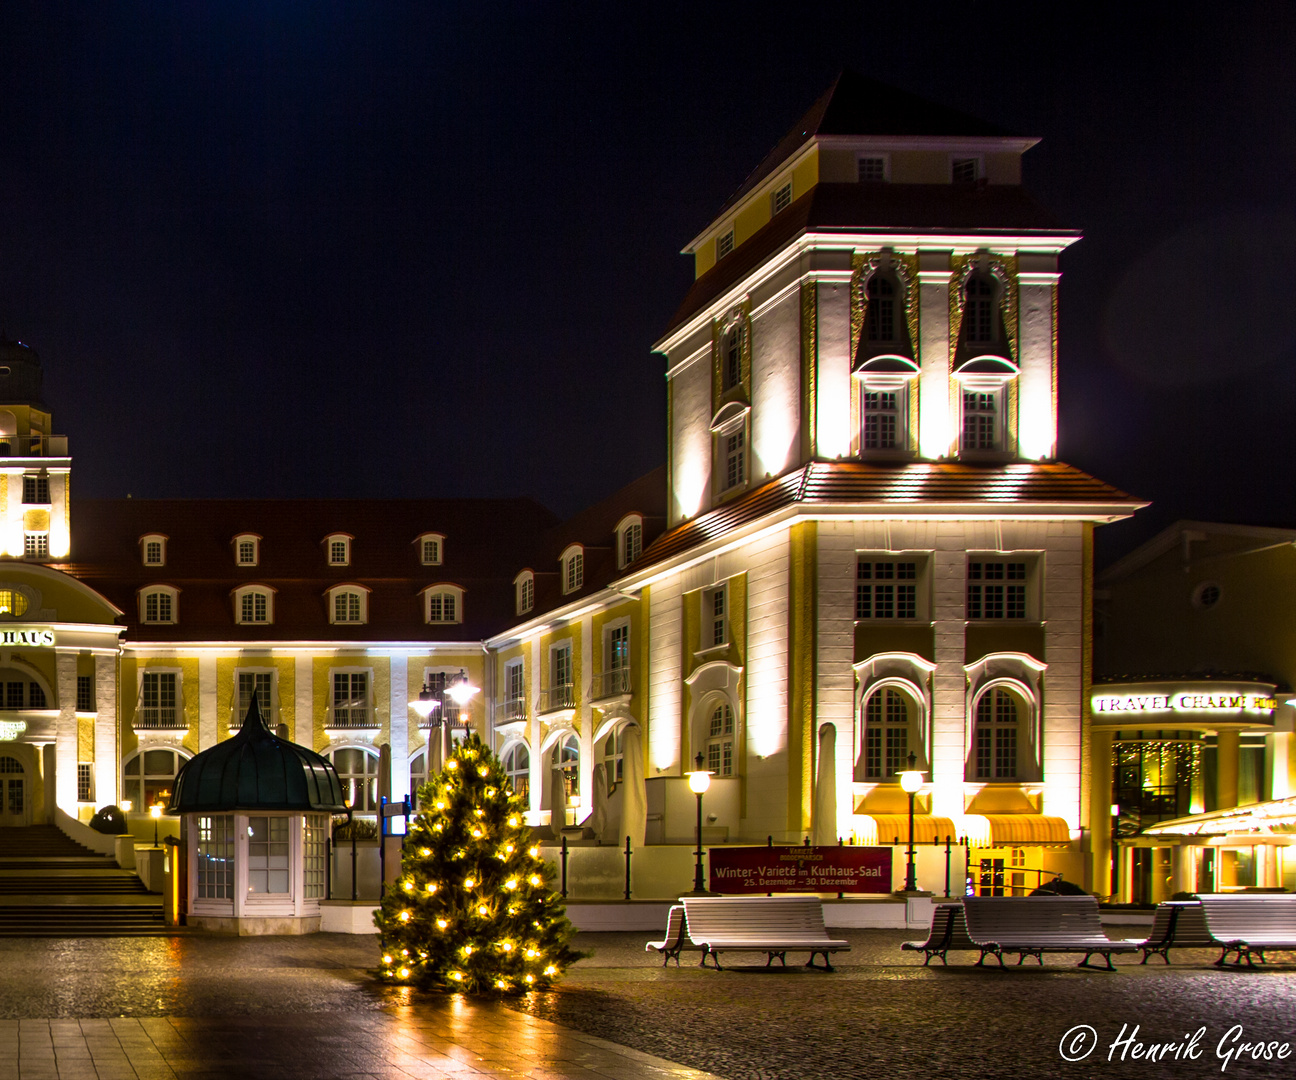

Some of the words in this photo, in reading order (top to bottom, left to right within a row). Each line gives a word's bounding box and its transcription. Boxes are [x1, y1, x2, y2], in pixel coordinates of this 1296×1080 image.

[1096, 697, 1174, 712] TRAVEL
[1179, 695, 1246, 709] CHARME
[715, 865, 796, 878] Winter-Varieté
[798, 868, 808, 876] im
[811, 865, 882, 877] Kurhaus-Saal
[743, 878, 757, 887] 25.
[759, 877, 795, 886] Dezember
[805, 878, 819, 886] 30.
[820, 877, 858, 886] Dezember
